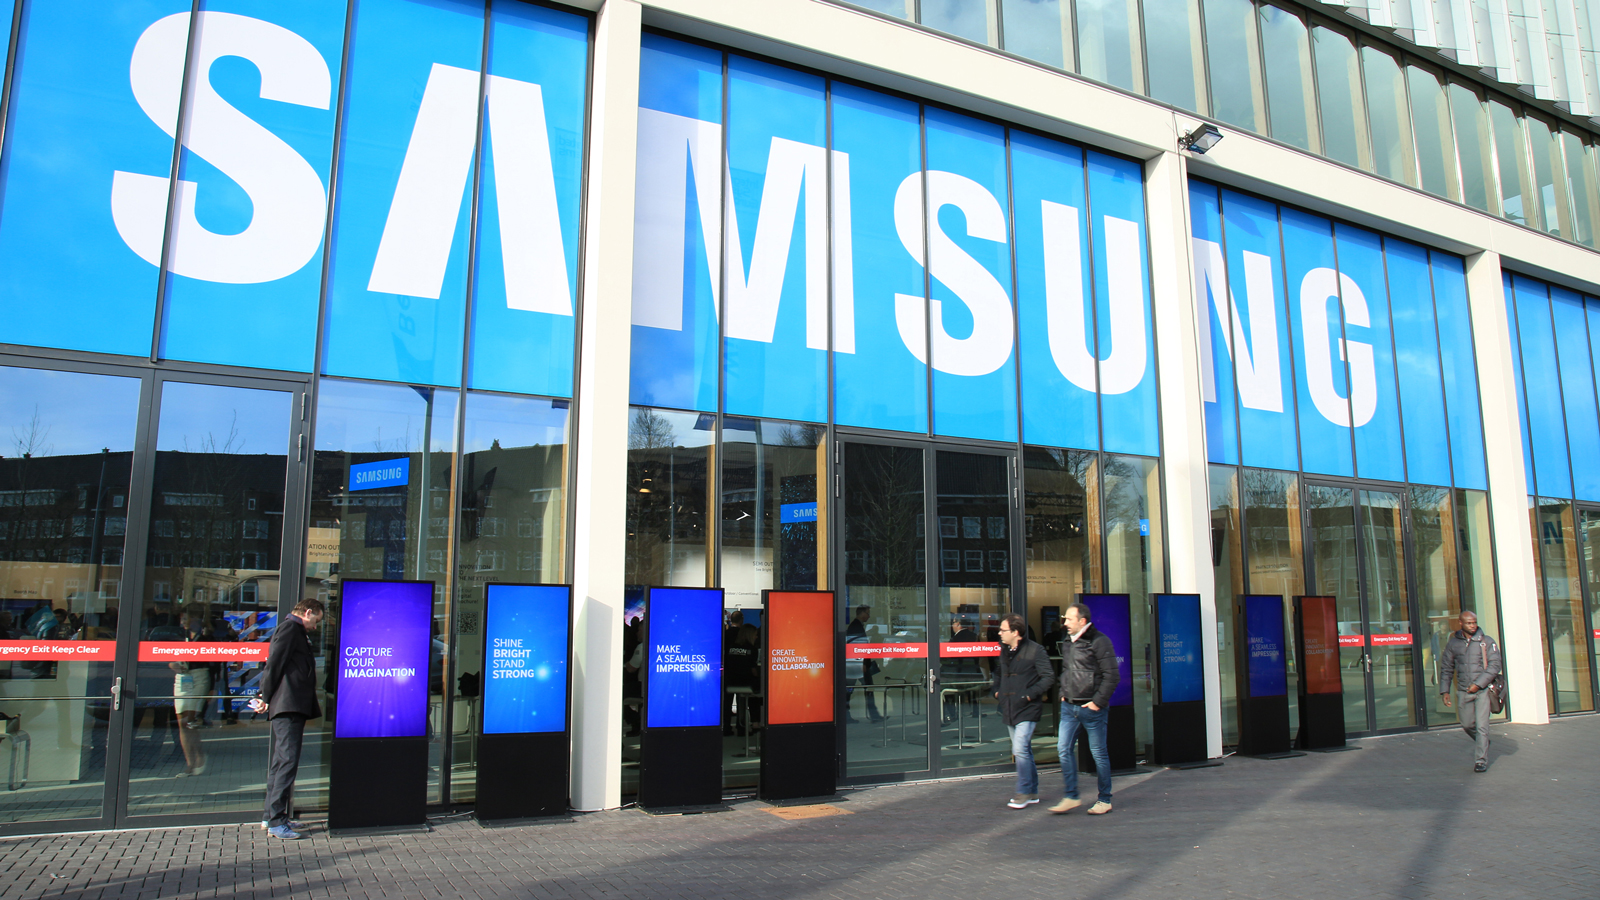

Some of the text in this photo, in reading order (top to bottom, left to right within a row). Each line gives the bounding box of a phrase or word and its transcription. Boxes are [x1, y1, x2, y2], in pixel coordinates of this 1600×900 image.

[110, 10, 1378, 427] SAMSUNG
[356, 467, 402, 484] SAMSUNG
[794, 508, 817, 518] SAMS
[494, 638, 523, 647] SHINE
[52, 646, 74, 654] Keep
[152, 647, 198, 655] Emergency
[218, 647, 238, 655] Keep
[346, 647, 392, 656] CAPTURE
[494, 649, 531, 658] BRIGHT
[657, 645, 681, 653] MAKE
[345, 658, 374, 667] YOUR
[493, 659, 525, 668] STAND
[772, 663, 824, 671] COLLABORATION
[656, 664, 709, 672] IMPRESSION
[344, 668, 416, 678] IMAGINATION
[493, 669, 534, 679] STRONG
